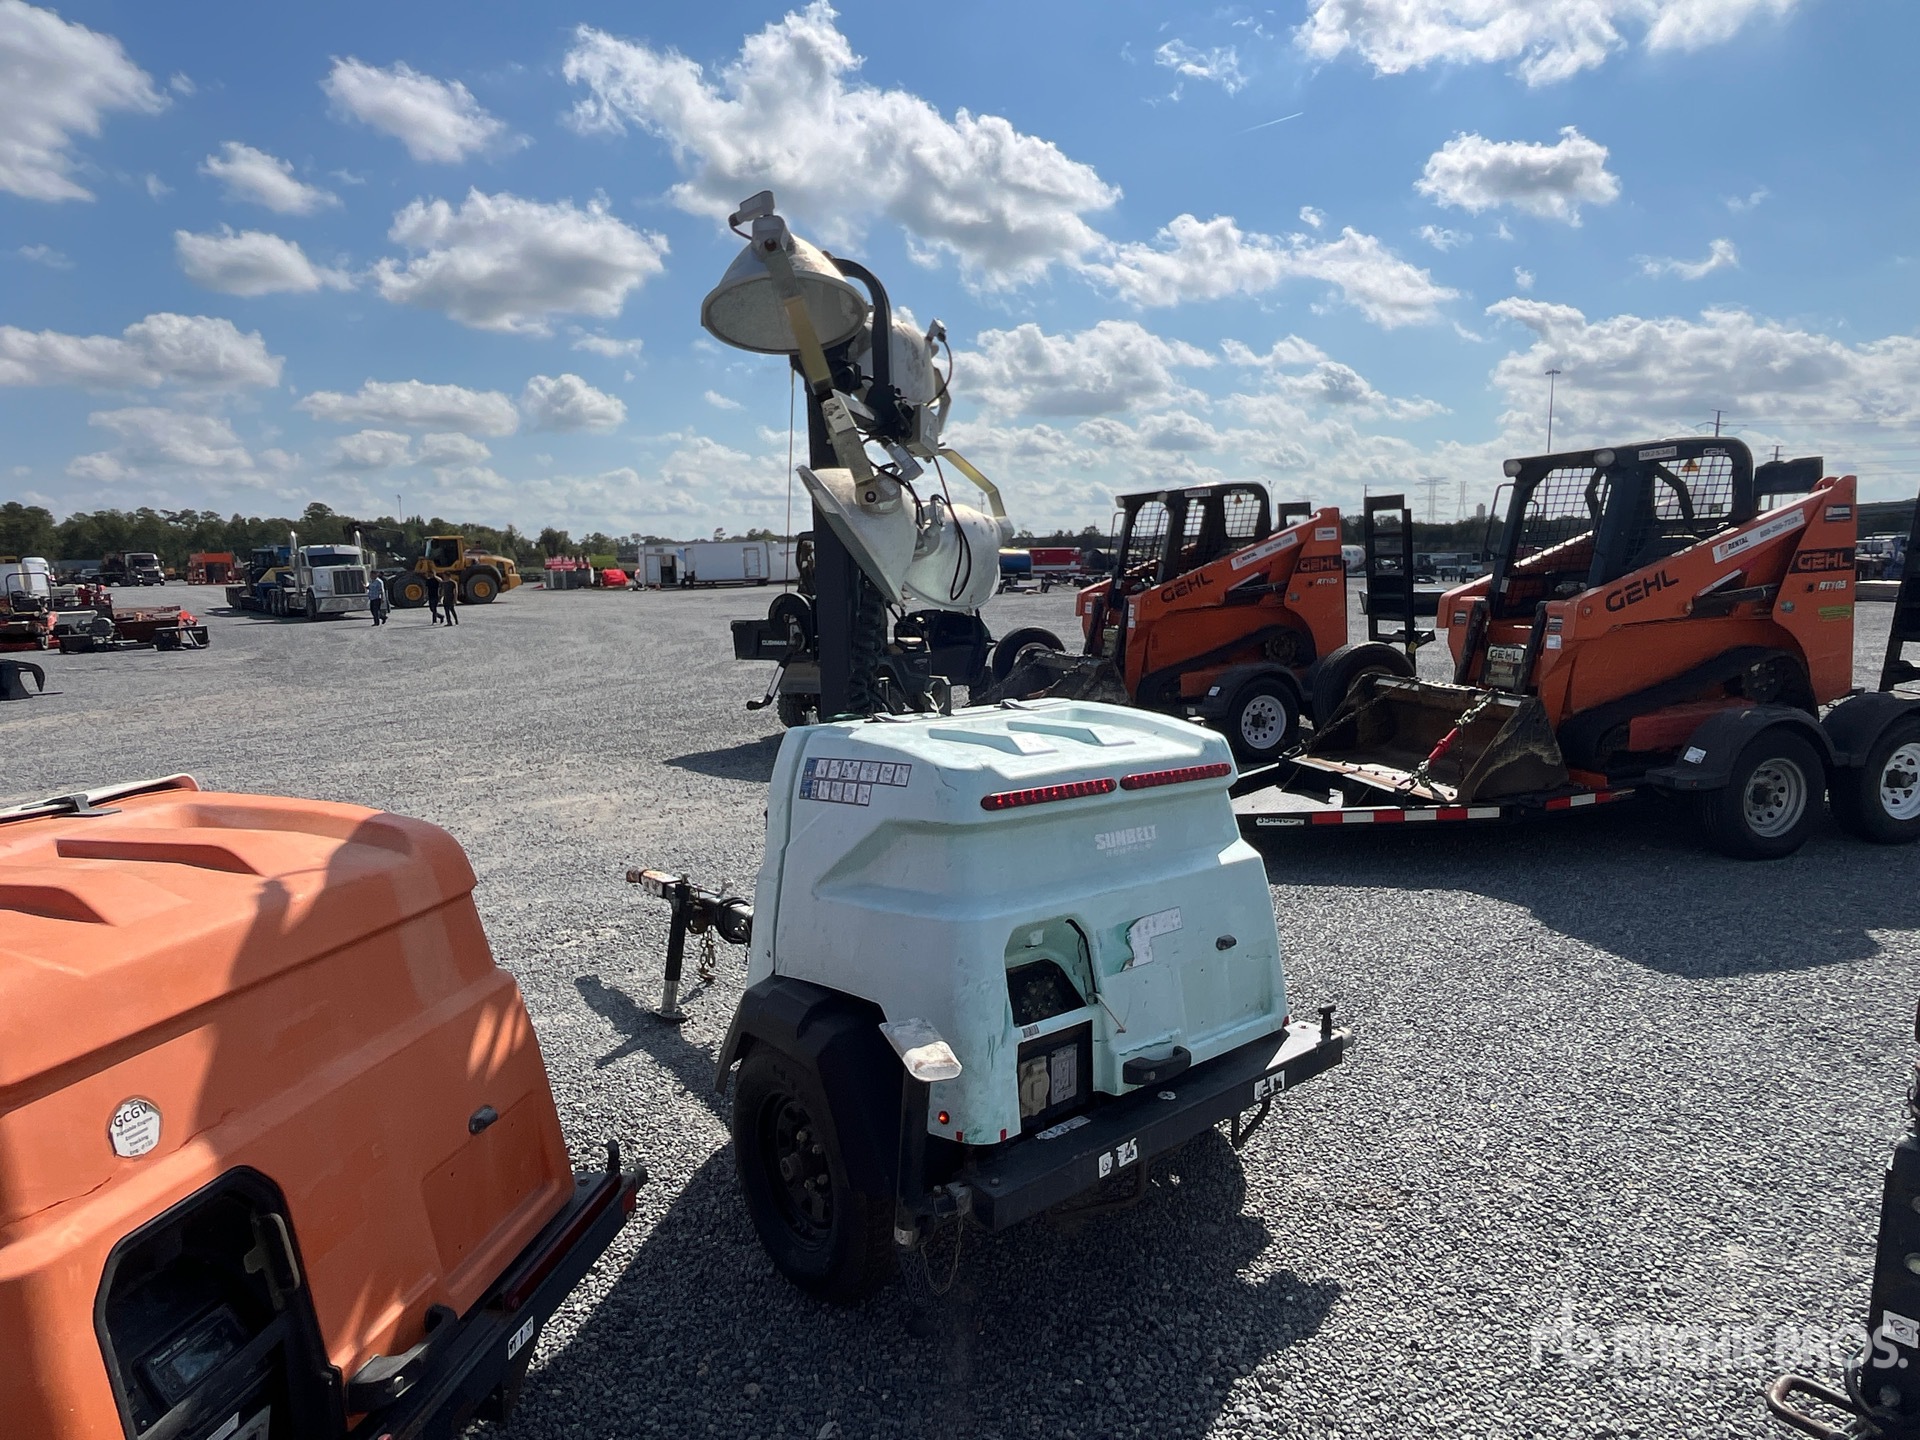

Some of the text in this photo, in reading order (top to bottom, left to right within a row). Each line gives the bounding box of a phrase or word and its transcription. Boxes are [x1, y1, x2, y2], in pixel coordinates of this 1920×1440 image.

[1703, 447, 1729, 456] GEHL
[1727, 537, 1748, 550] RENTAL
[1300, 558, 1339, 571] GEHL
[1797, 552, 1851, 570] GEHL
[1161, 572, 1214, 603] GEHL
[1605, 569, 1679, 612] GEHL
[1490, 649, 1520, 662] GEHL
[1094, 825, 1157, 850] SUNBELT
[114, 1102, 148, 1128] GCGV
